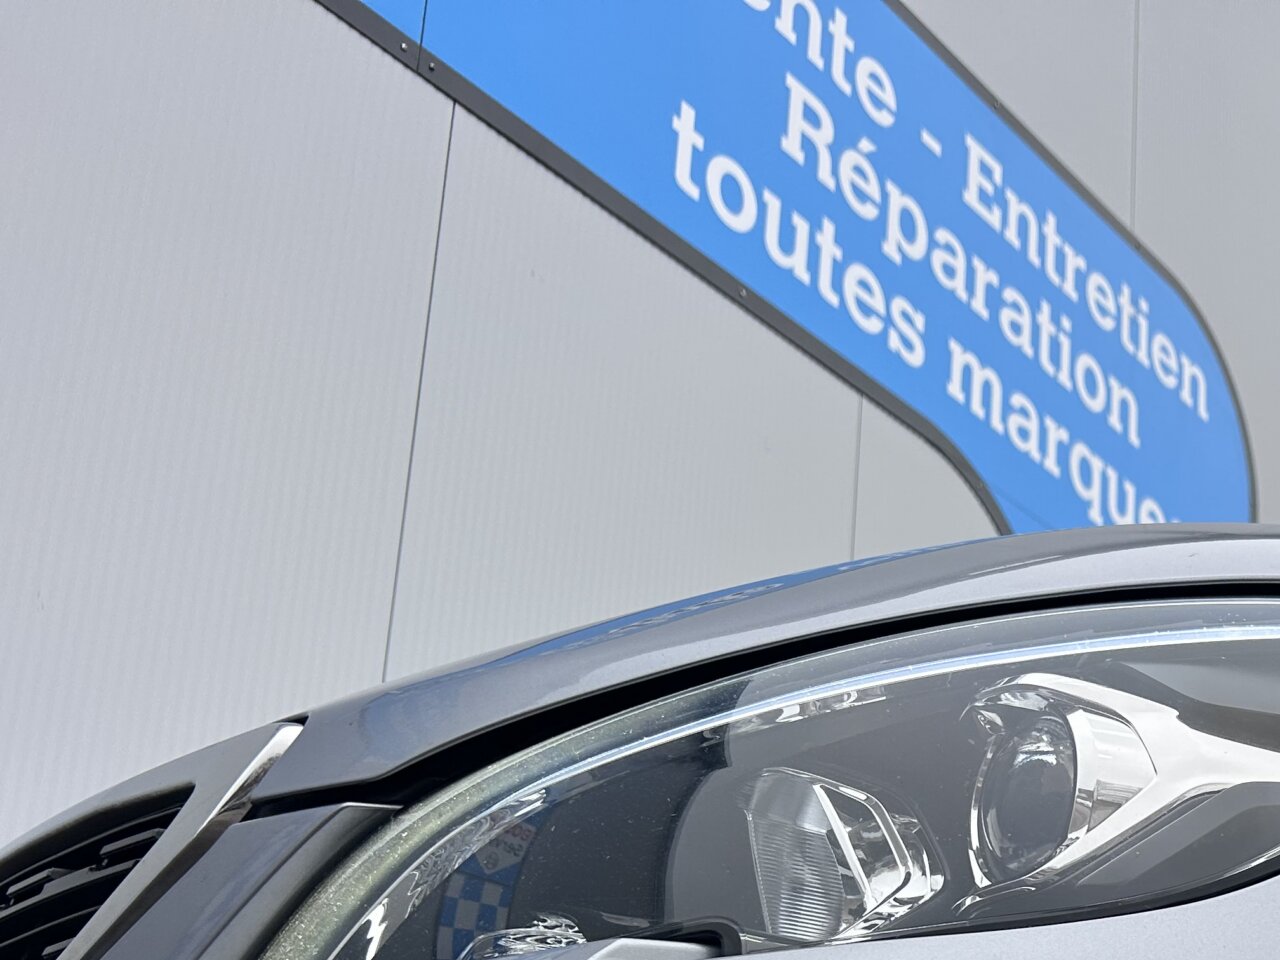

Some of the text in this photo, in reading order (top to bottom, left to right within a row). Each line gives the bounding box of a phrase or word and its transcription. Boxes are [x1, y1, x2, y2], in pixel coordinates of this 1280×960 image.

[671, 99, 926, 368] toutes
[741, 0, 897, 128] nte
[961, 132, 1210, 423] Entretien
[780, 72, 1142, 449] Réparation
